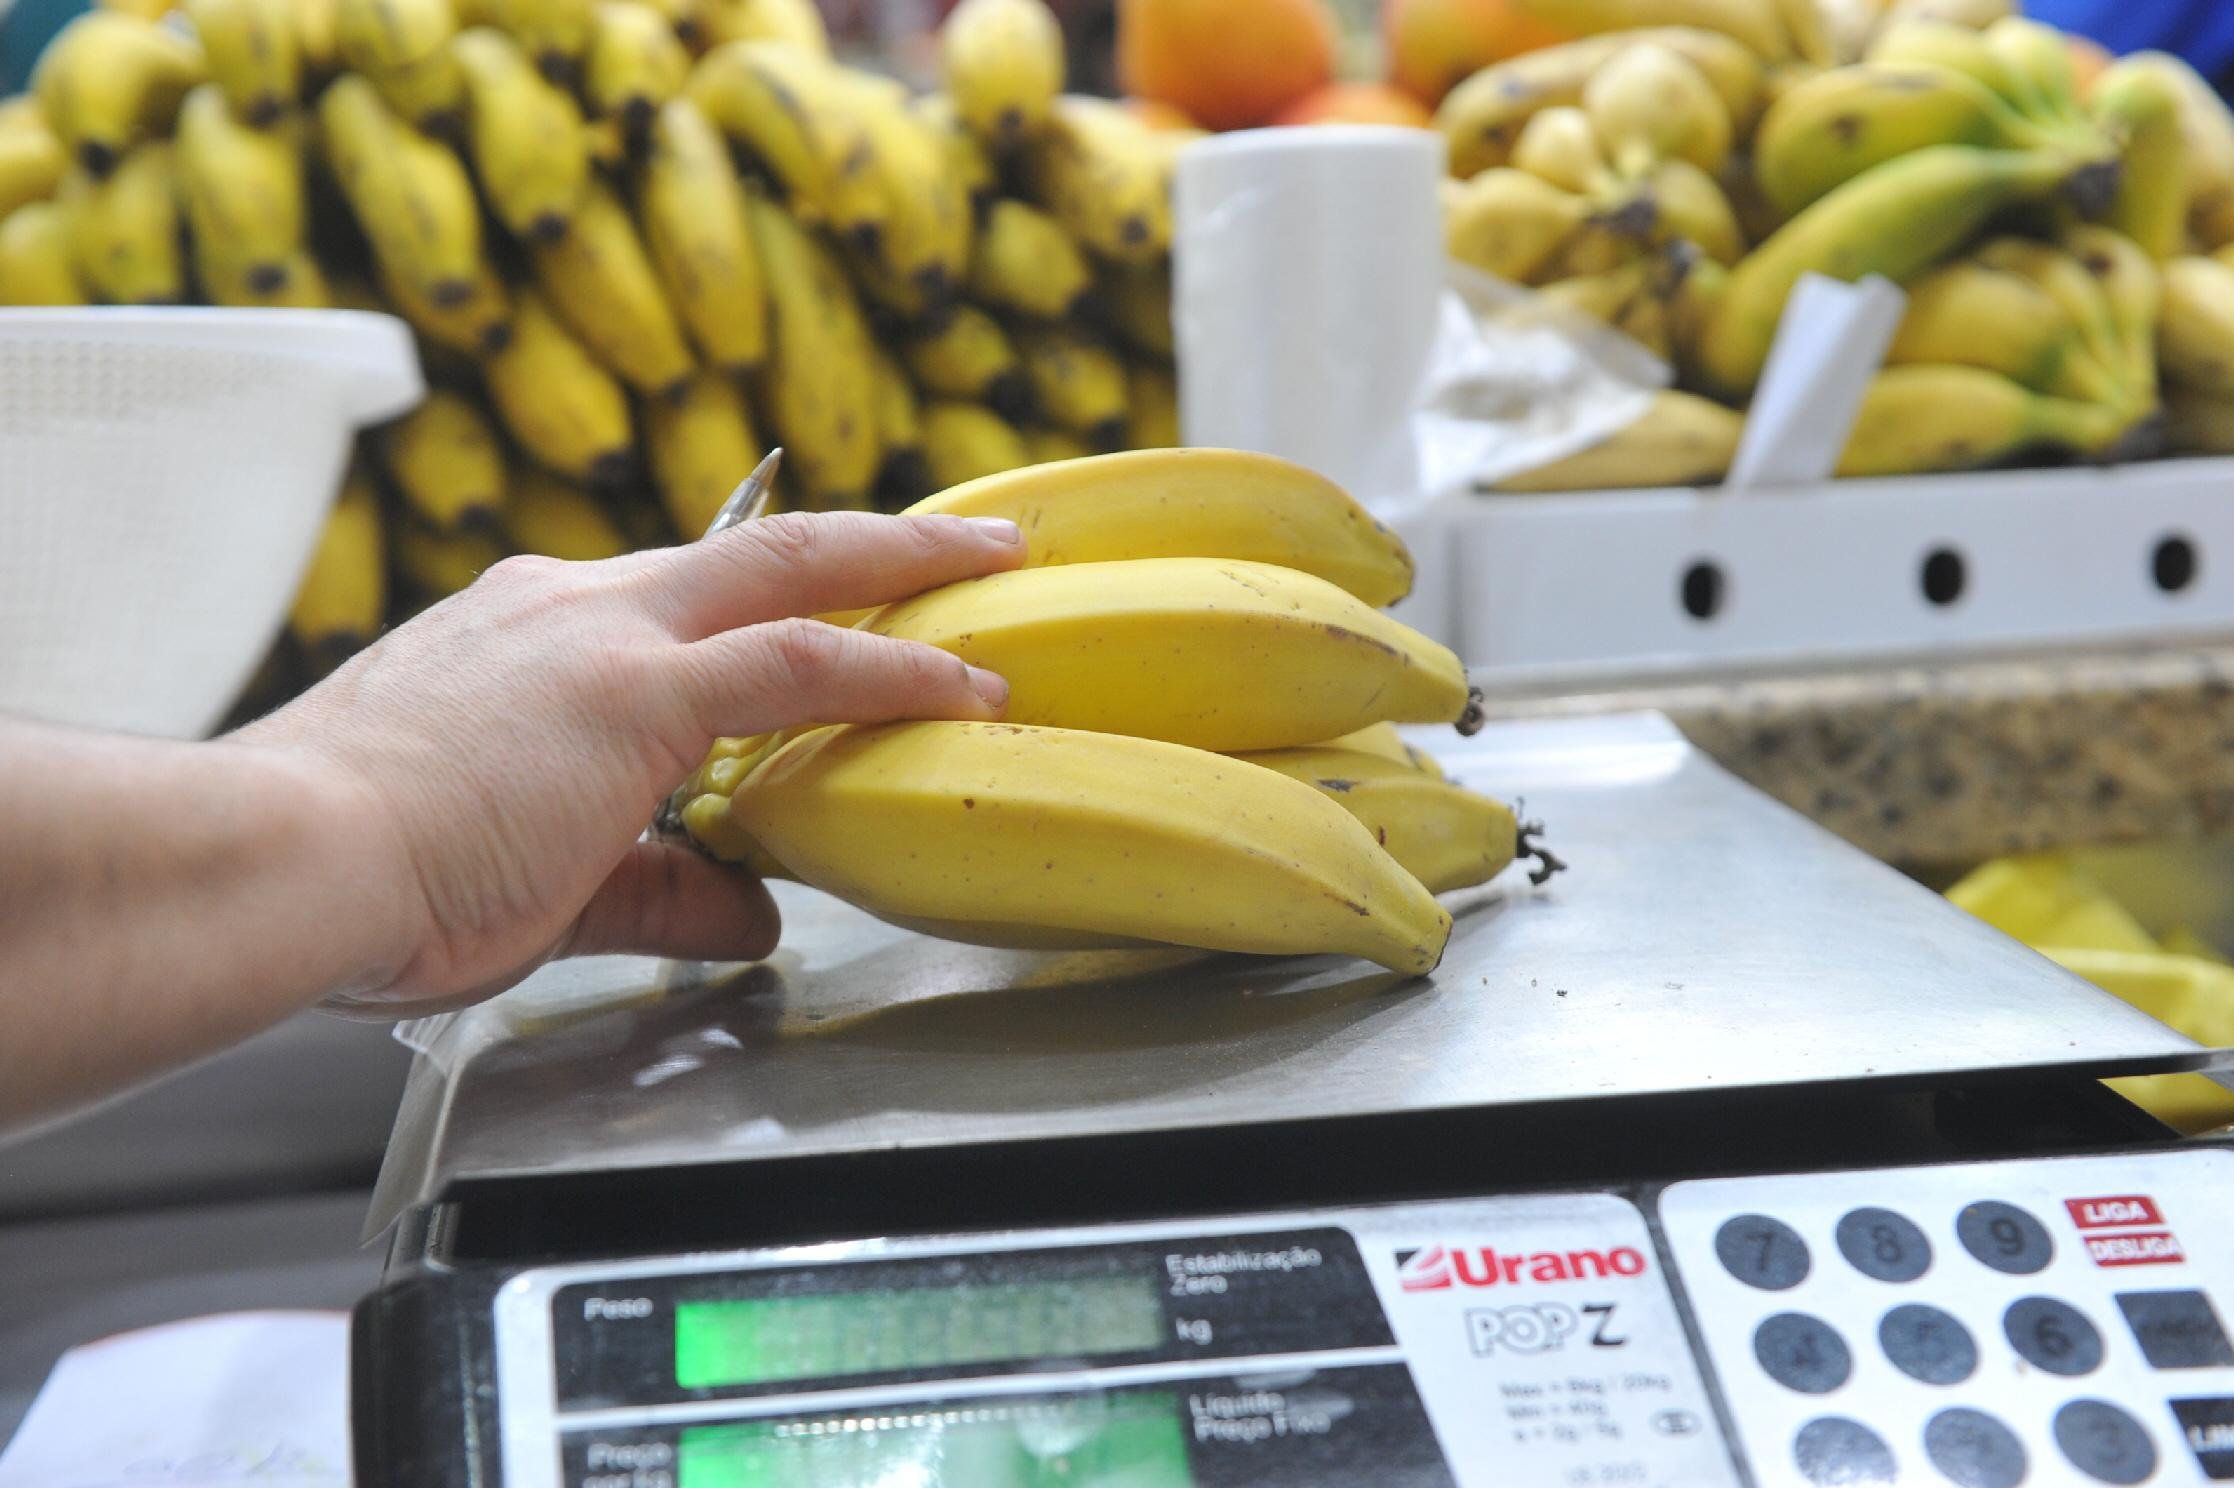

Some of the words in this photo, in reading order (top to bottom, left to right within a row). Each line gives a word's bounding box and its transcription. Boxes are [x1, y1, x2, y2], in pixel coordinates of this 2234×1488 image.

[2083, 1201, 2149, 1223] LIGA
[1745, 1230, 1776, 1273] 7
[1869, 1224, 1906, 1266] 8
[1989, 1216, 2025, 1257] 9
[2088, 1236, 2183, 1260] DESLIGA
[1165, 1246, 1322, 1276] Estabilização
[1451, 1246, 1647, 1288] Urano
[1170, 1274, 1228, 1296] Zero
[583, 1297, 653, 1321] Peso
[1176, 1317, 1213, 1345] kg
[1463, 1301, 1579, 1357] POP
[1582, 1303, 1628, 1347] Z
[2035, 1313, 2076, 1360] 6
